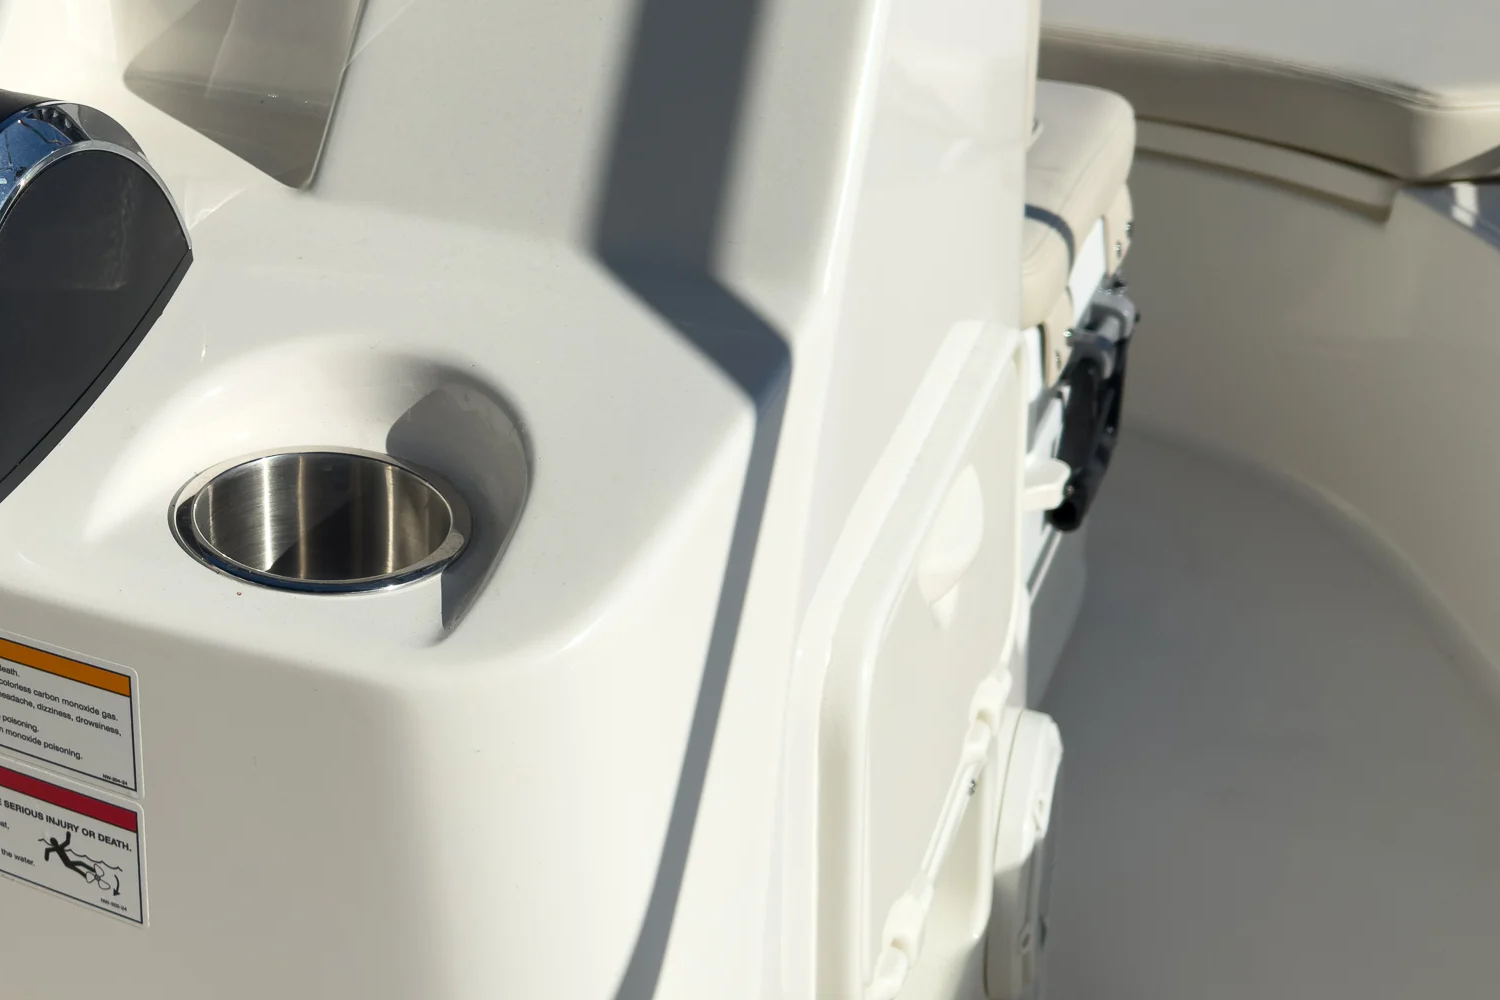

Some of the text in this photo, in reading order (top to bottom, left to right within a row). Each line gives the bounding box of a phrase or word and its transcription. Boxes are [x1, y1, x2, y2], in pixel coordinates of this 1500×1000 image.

[32, 689, 60, 703] carbon
[61, 698, 99, 715] monoxide
[101, 710, 118, 721] gas.
[36, 702, 73, 721] dizziness,
[75, 715, 121, 736] drowsiness,
[2, 714, 39, 733] poisoning.
[5, 728, 42, 746] monoxide
[43, 741, 82, 760] poisoning.
[3, 799, 44, 820] SERIOUS
[45, 814, 79, 832] INJURY
[81, 827, 95, 839] OR
[97, 832, 131, 851] DEATH.
[0, 848, 12, 858] the
[13, 854, 34, 866] water.
